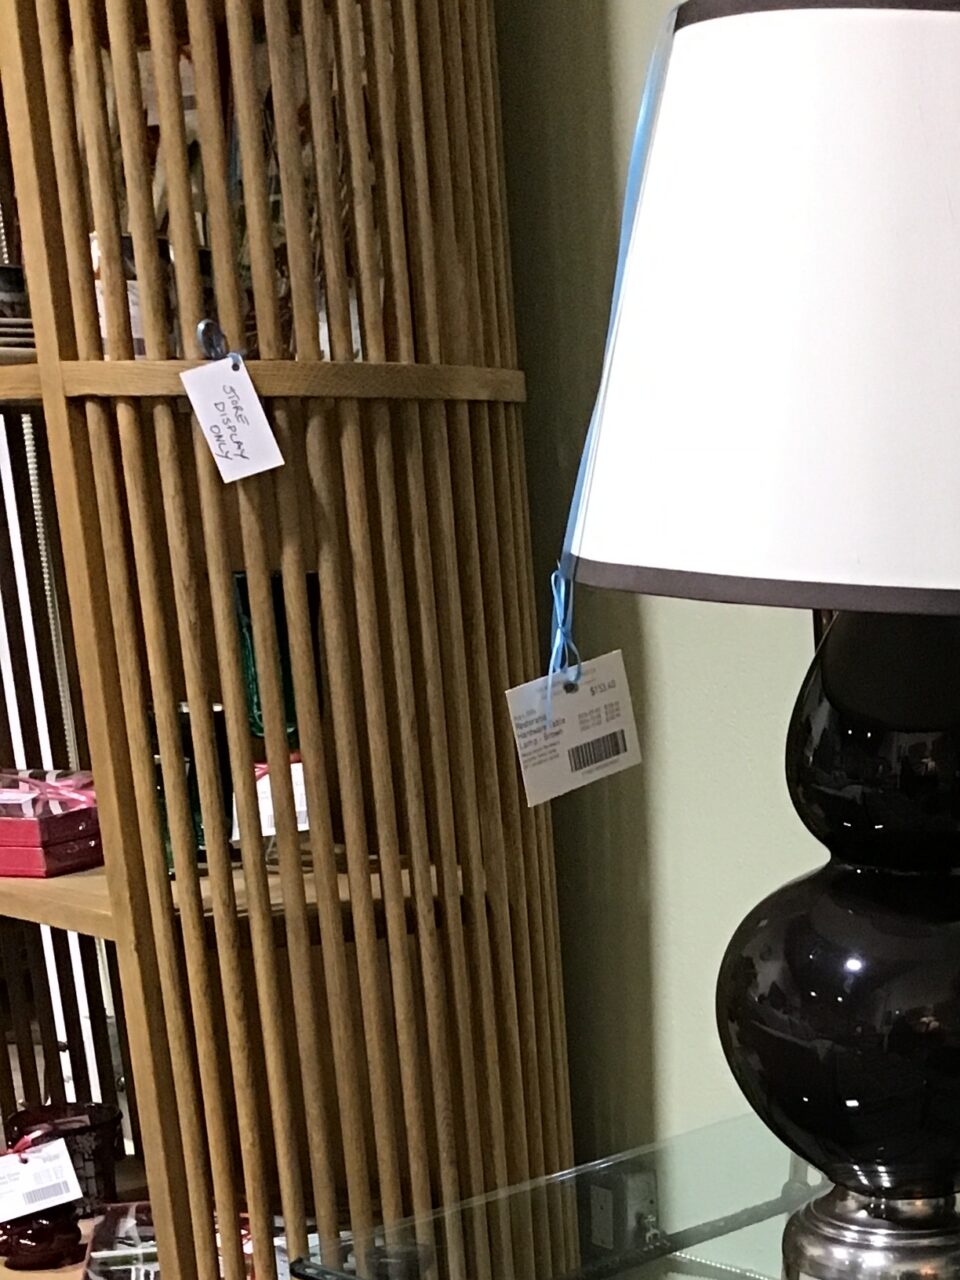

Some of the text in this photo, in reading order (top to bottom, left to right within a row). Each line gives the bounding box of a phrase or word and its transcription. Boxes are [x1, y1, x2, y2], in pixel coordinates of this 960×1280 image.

[223, 385, 249, 426] STORE
[210, 425, 233, 461] ONLY
[214, 401, 250, 460] DISPLAY
